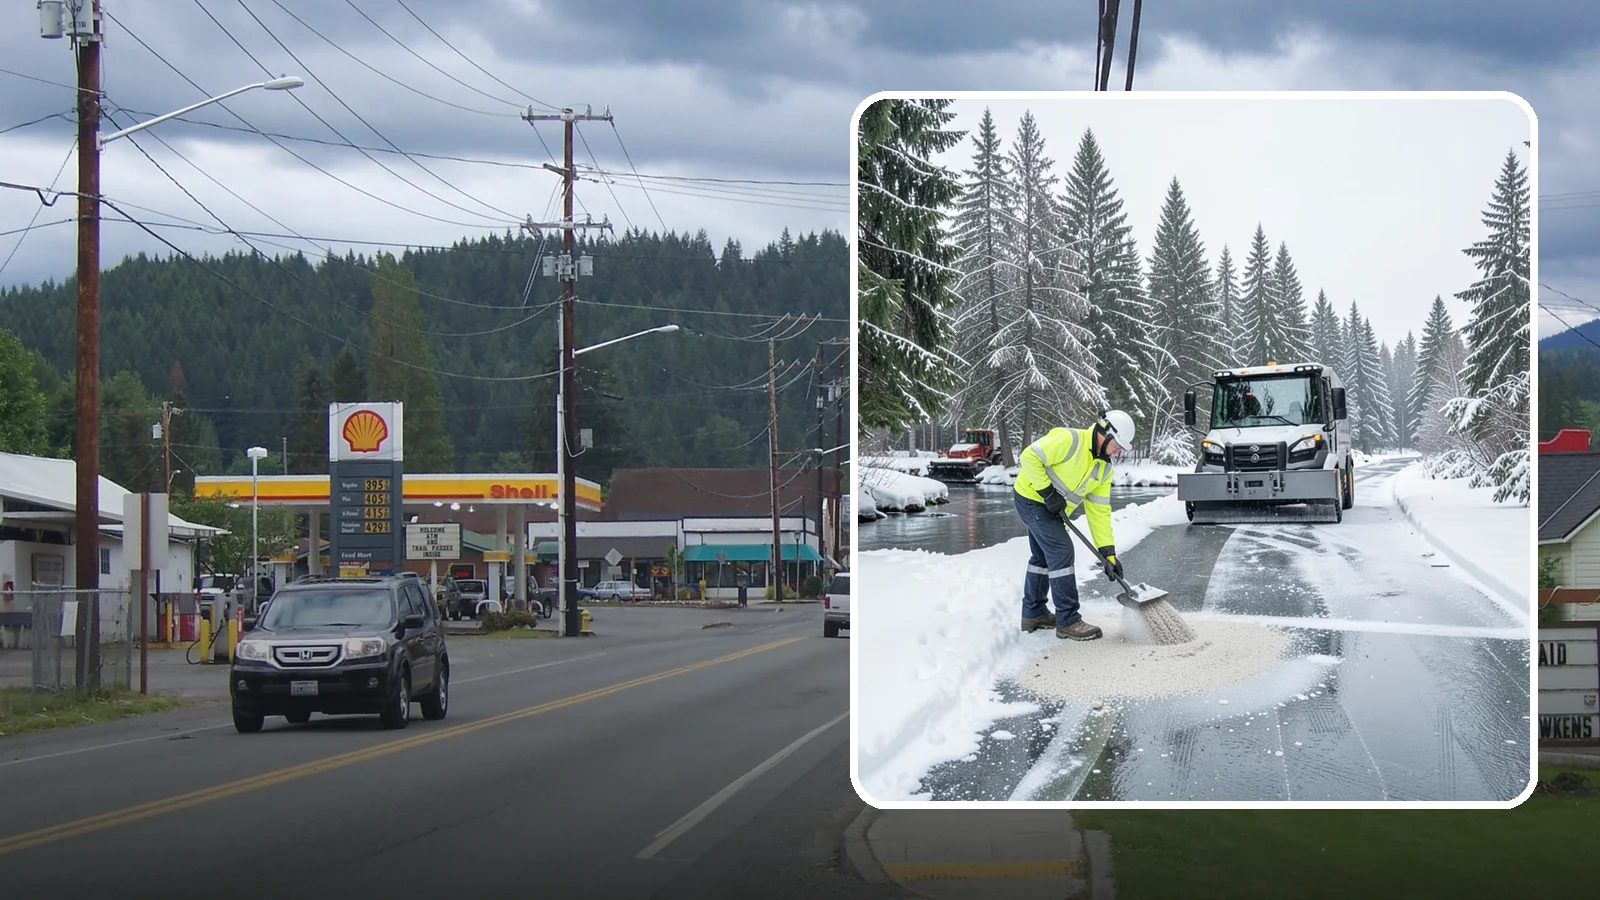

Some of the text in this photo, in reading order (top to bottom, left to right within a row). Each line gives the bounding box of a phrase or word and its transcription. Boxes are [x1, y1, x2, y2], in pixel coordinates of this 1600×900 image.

[365, 480, 383, 490] 395
[490, 484, 547, 499] Shell
[366, 494, 383, 504] 405
[366, 508, 383, 518] 415
[366, 522, 384, 533] 429
